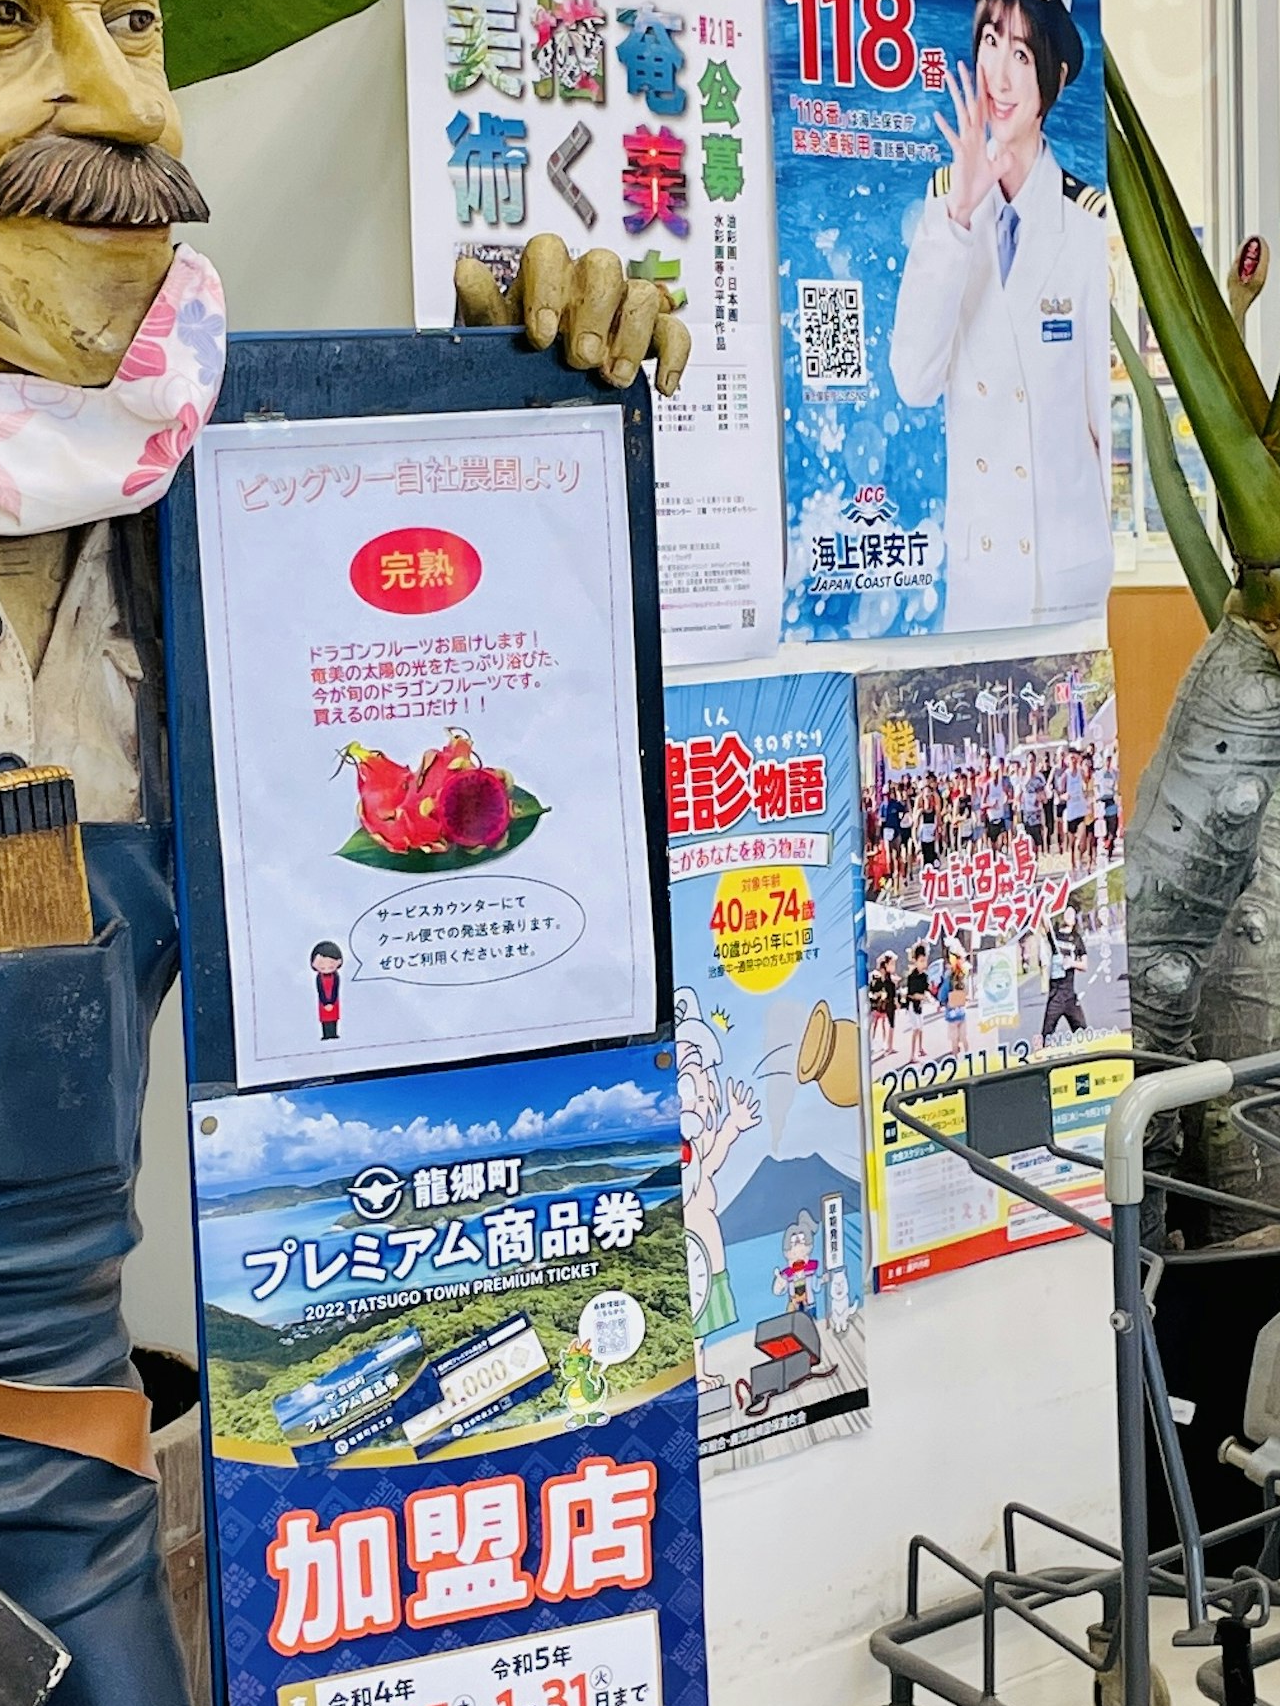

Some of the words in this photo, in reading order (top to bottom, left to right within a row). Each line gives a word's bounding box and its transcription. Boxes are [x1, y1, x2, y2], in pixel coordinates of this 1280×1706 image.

[698, 57, 744, 202] 公募
[238, 456, 582, 512] ビッグツー自社農園より
[855, 486, 885, 503] JCG
[380, 550, 454, 590] 完熟
[812, 532, 928, 572] 海上保安庁
[811, 575, 852, 592] JAPAN
[855, 574, 892, 590] COAST
[894, 571, 933, 588] GUARD
[310, 631, 538, 663] ドラゴンフルーツお届けします！
[311, 650, 560, 685] 奄美の太陽の光をたっぷり浴びた、
[312, 673, 541, 705] 今が旬のドラゴンフルーツです。
[314, 696, 486, 726] 買えるのはココだけ！！
[754, 729, 822, 754] ものがたり
[377, 895, 527, 922] サービスカウンターにて
[926, 869, 1071, 944] ハーフマラソン
[378, 917, 561, 947] クール便での発送を承ります。
[713, 927, 814, 960] 40歳から1年に1回
[379, 943, 536, 971] ぜひご利用くださいませ。
[413, 1157, 522, 1209] 龍郷町
[243, 1191, 645, 1301] プレミアム商品券
[304, 1301, 346, 1323] 2022
[348, 1290, 422, 1315] TATSUGO
[425, 1282, 472, 1304] TOWN
[474, 1271, 545, 1296] PREMIUM
[546, 1261, 600, 1286] TICKET
[304, 1370, 402, 1434] プレミアム商品券
[268, 1459, 657, 1655] 加盟店
[490, 1644, 574, 1681] 令和5年
